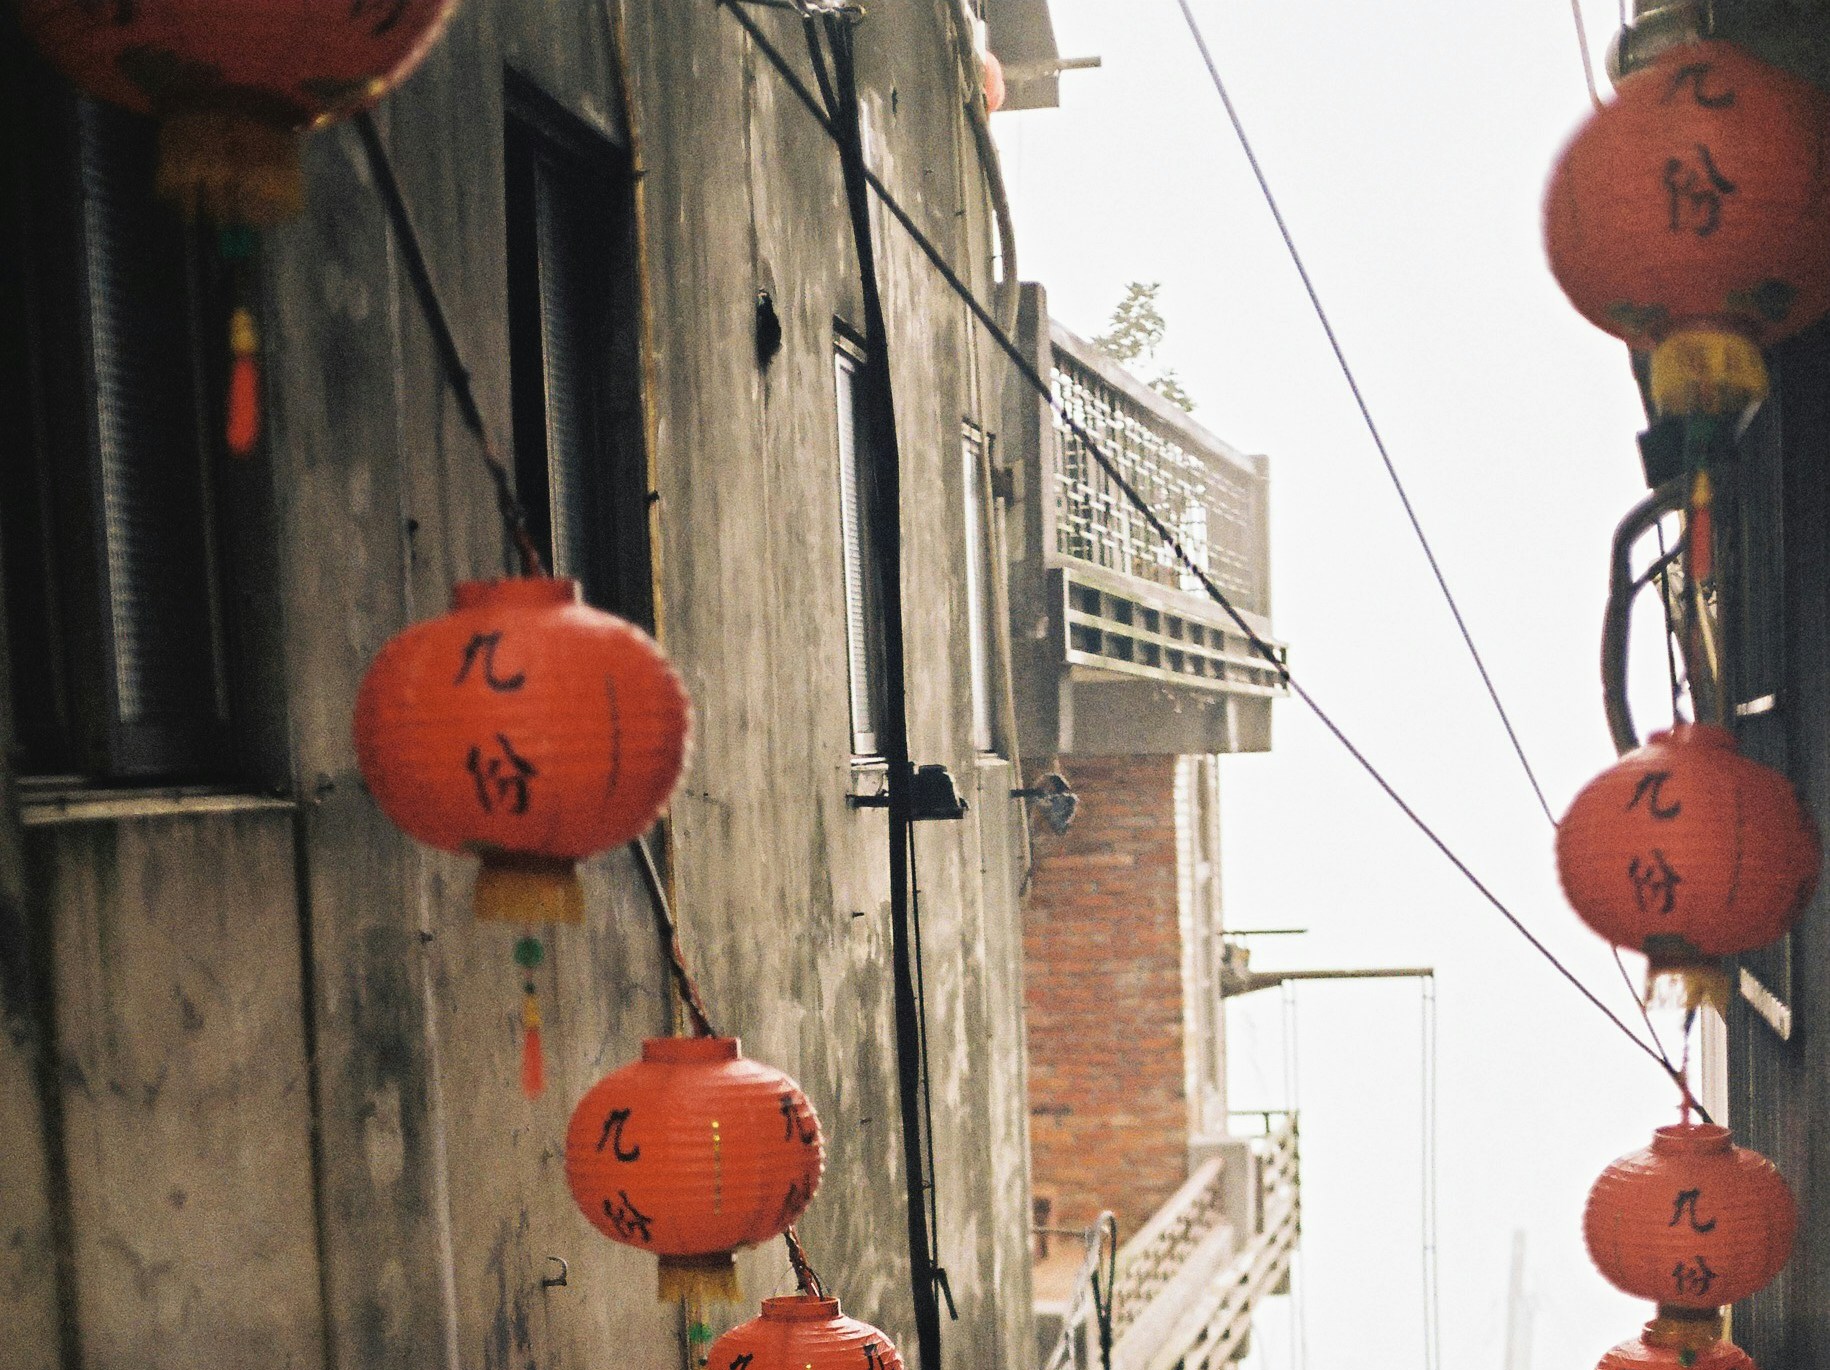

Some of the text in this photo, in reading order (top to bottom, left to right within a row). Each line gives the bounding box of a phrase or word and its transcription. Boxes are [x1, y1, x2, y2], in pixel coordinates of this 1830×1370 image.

[1659, 62, 1737, 237] 九份
[452, 630, 538, 815] 九份
[1625, 771, 1683, 914] 九份
[596, 1107, 654, 1243] 九份
[1668, 1186, 1719, 1297] 九份
